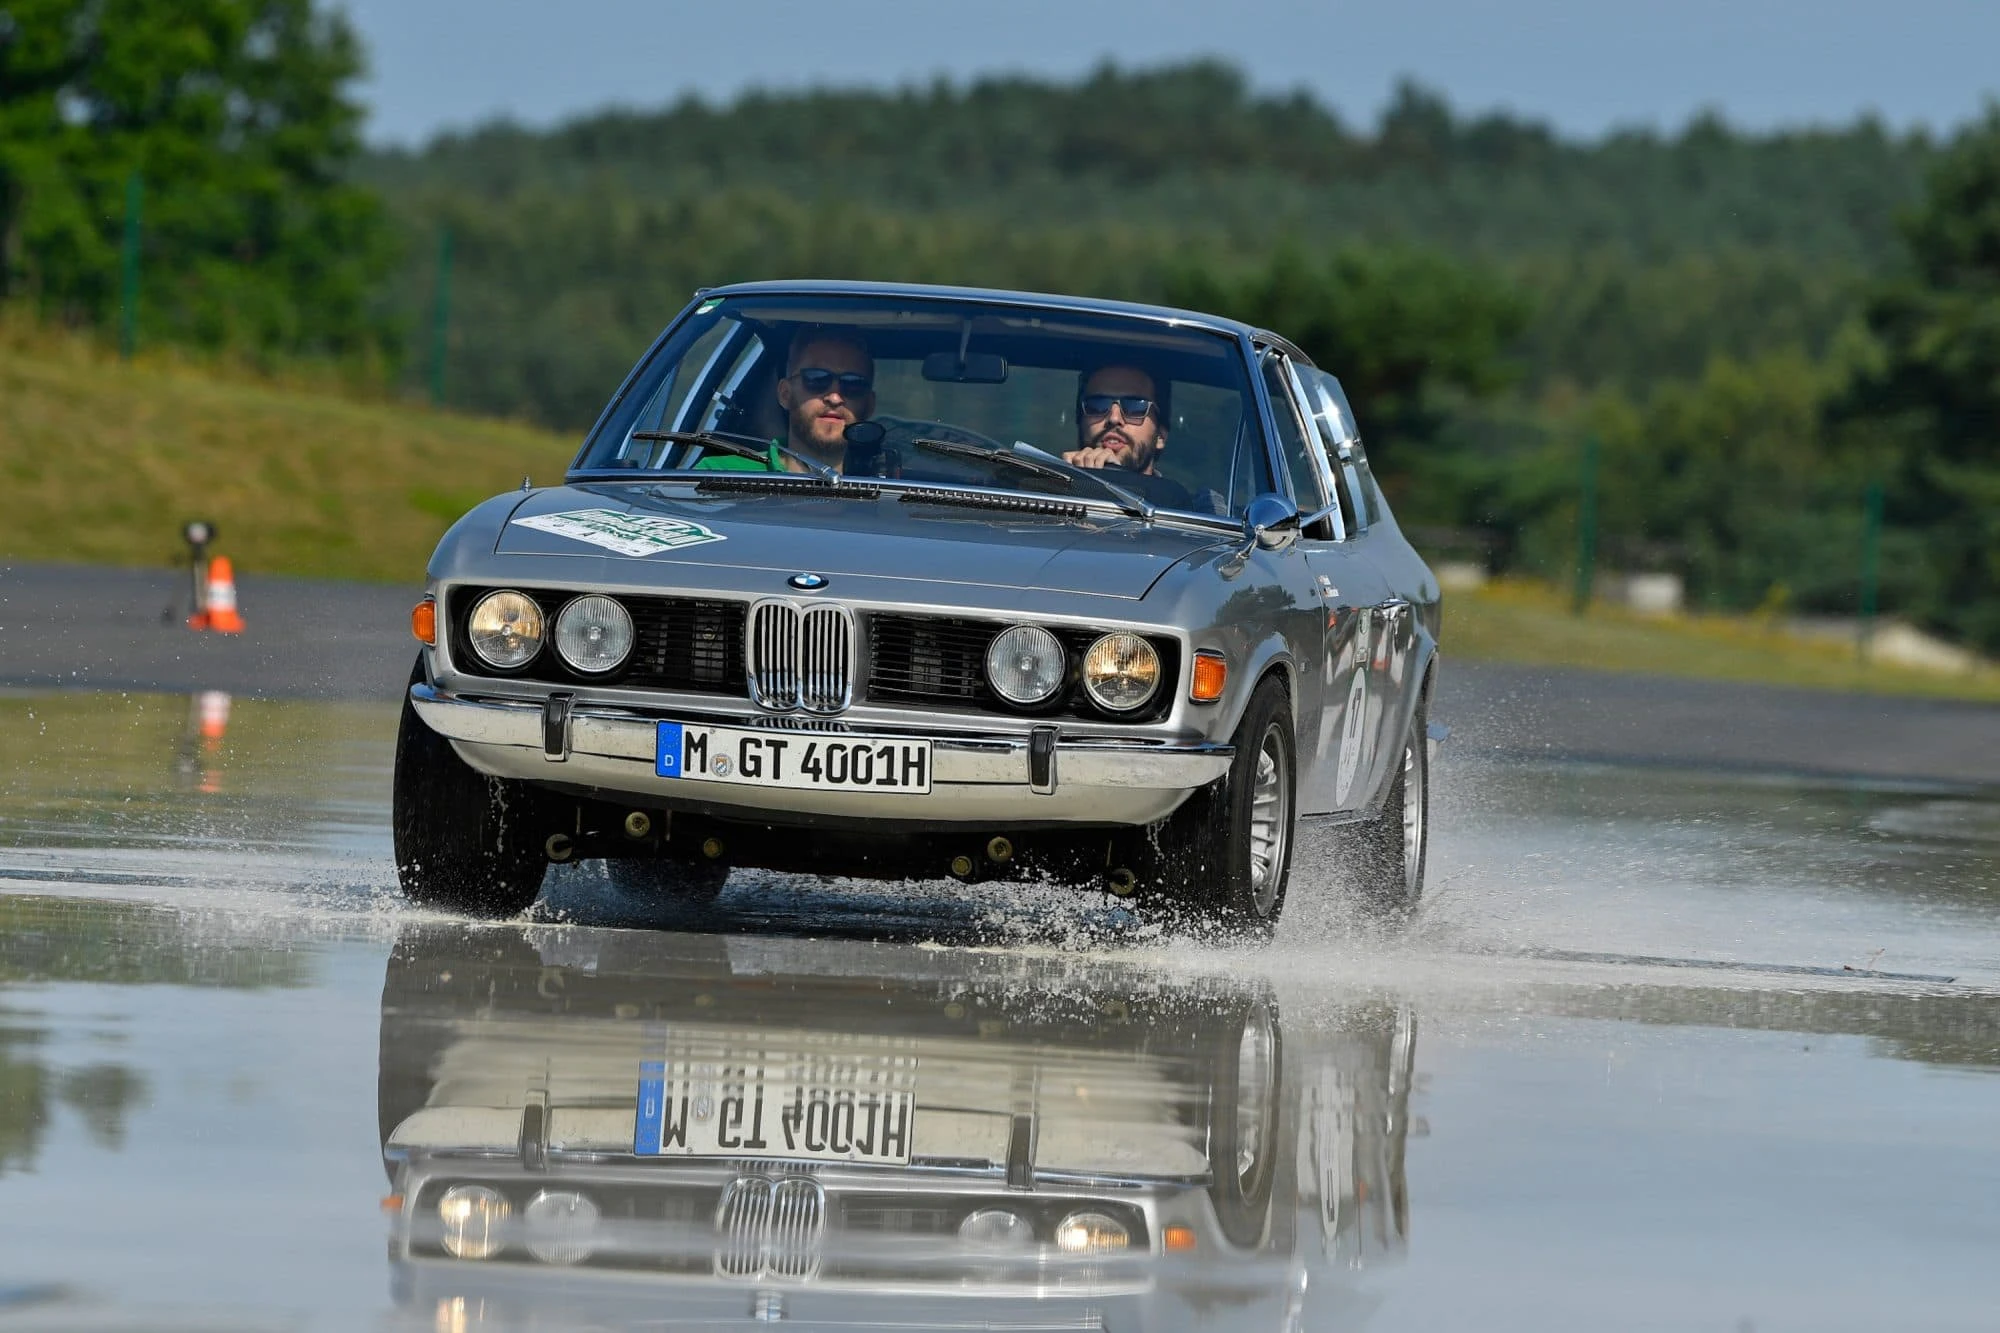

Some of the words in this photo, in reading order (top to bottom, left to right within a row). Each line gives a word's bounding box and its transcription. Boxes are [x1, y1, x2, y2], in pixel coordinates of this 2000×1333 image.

[664, 755, 674, 766] D
[684, 732, 708, 773] M
[739, 737, 788, 780] GT
[801, 742, 925, 786] 4001H
